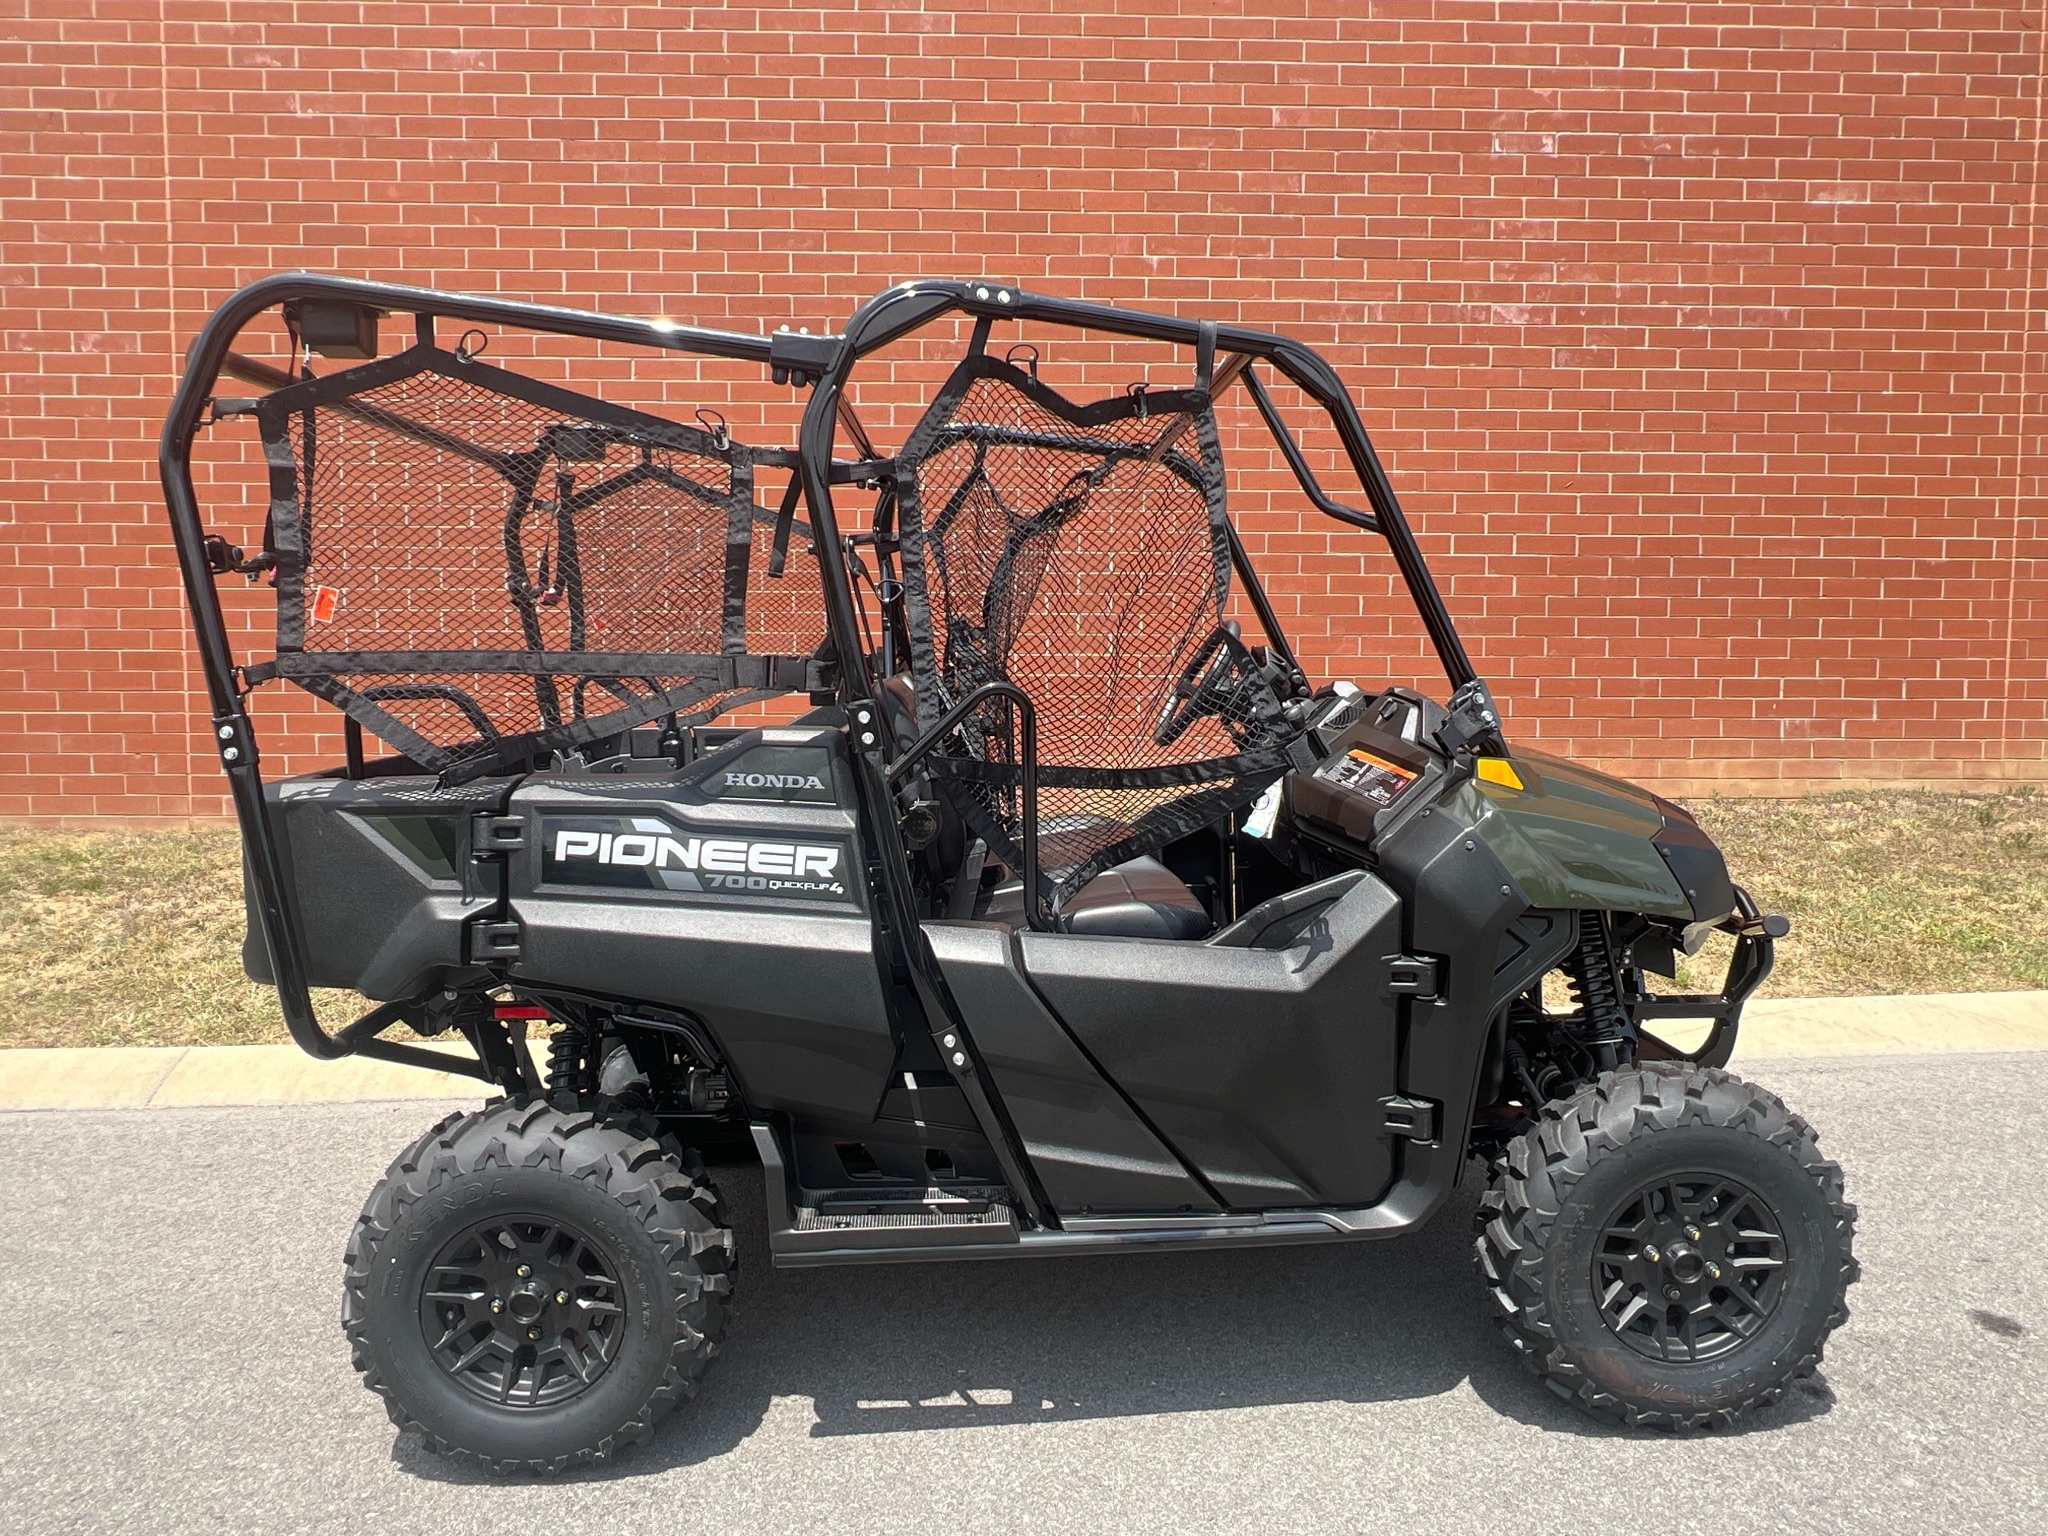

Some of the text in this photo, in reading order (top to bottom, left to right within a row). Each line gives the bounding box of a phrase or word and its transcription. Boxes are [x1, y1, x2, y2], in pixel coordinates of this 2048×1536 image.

[725, 772, 825, 790] HONDA
[554, 830, 839, 878] PIONEER
[704, 873, 768, 890] 700
[399, 1177, 509, 1252] KENDA
